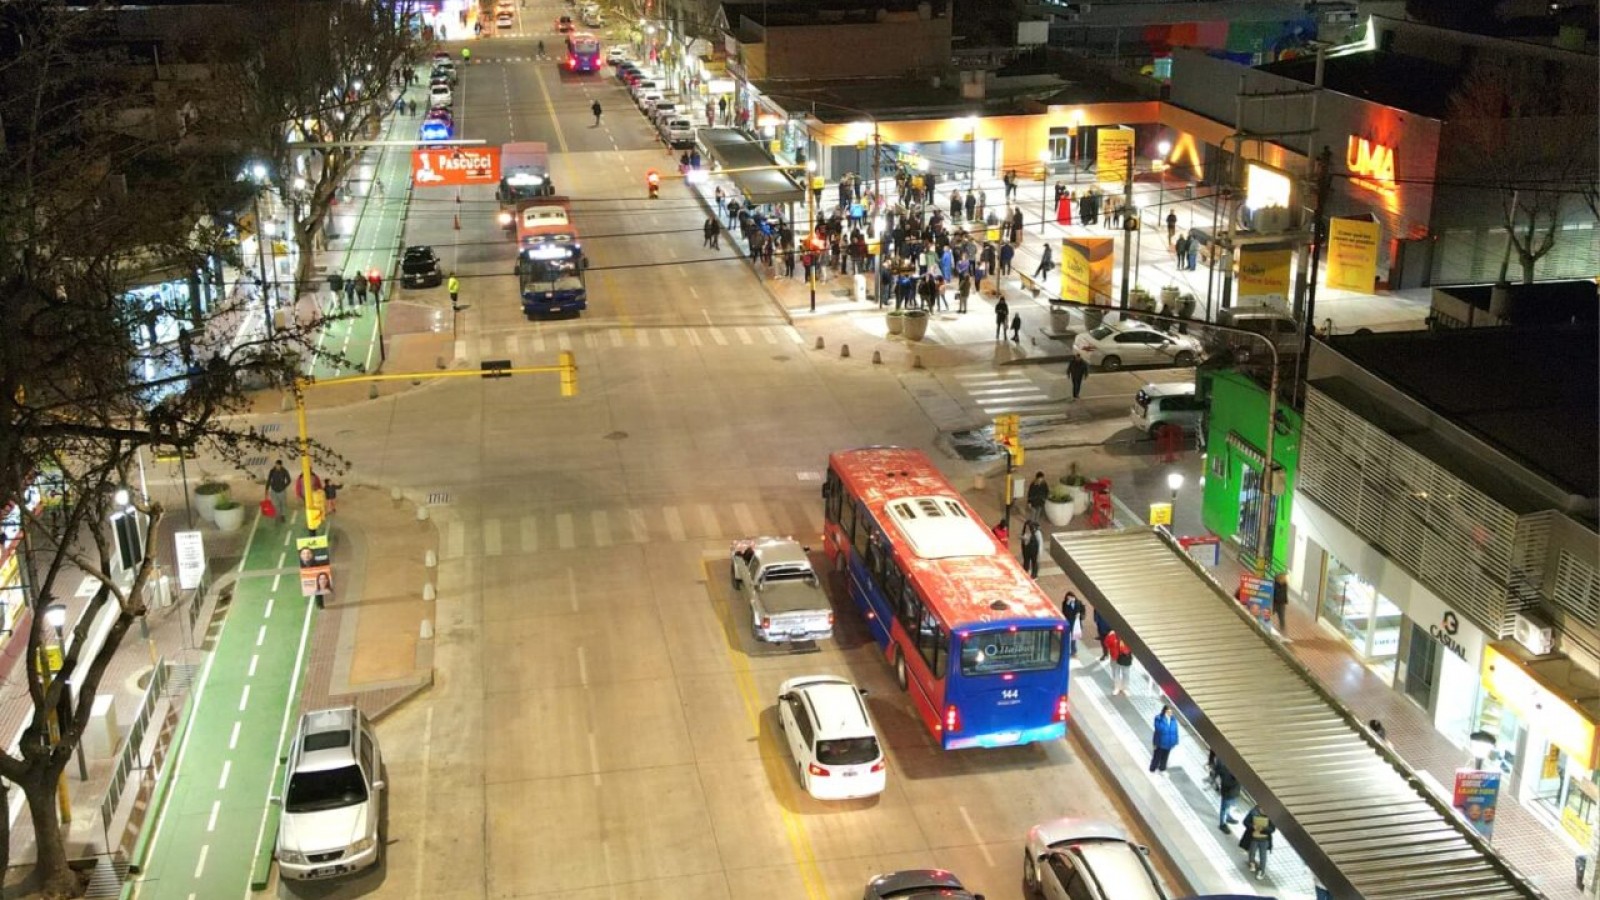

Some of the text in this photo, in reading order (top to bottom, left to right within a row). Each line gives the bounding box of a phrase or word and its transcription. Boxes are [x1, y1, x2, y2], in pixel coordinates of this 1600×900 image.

[1346, 134, 1396, 187] UMA
[1430, 624, 1467, 662] CASUAL
[1001, 689, 1019, 699] 144
